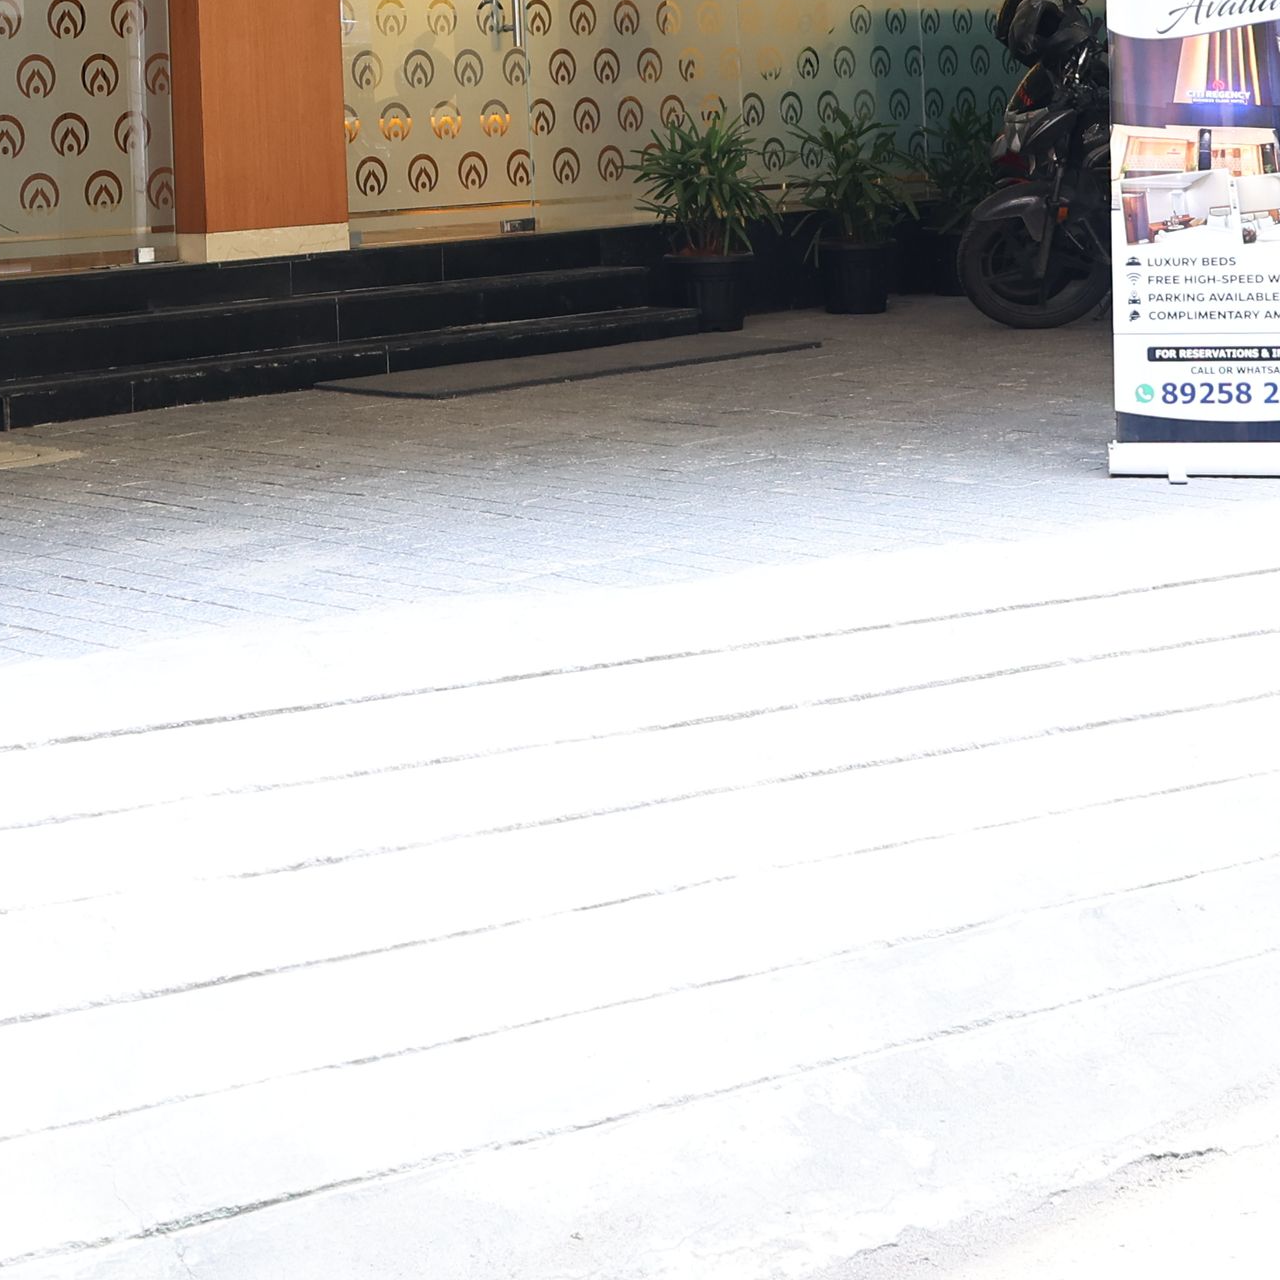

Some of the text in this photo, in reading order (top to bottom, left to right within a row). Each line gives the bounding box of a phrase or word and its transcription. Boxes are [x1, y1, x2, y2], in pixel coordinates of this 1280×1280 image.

[1147, 257, 1236, 266] LUXURY BEDS
[1148, 276, 1180, 284] FREE
[1184, 275, 1264, 284] HIGH-SPEED
[1148, 292, 1280, 302] PARKING AVAILABLE
[1149, 311, 1260, 320] COMPLIMENTARY
[1155, 349, 1177, 358] FOR
[1179, 349, 1259, 358] RESERVATIONS
[1261, 349, 1270, 358] &
[1161, 382, 1252, 404] 89258
